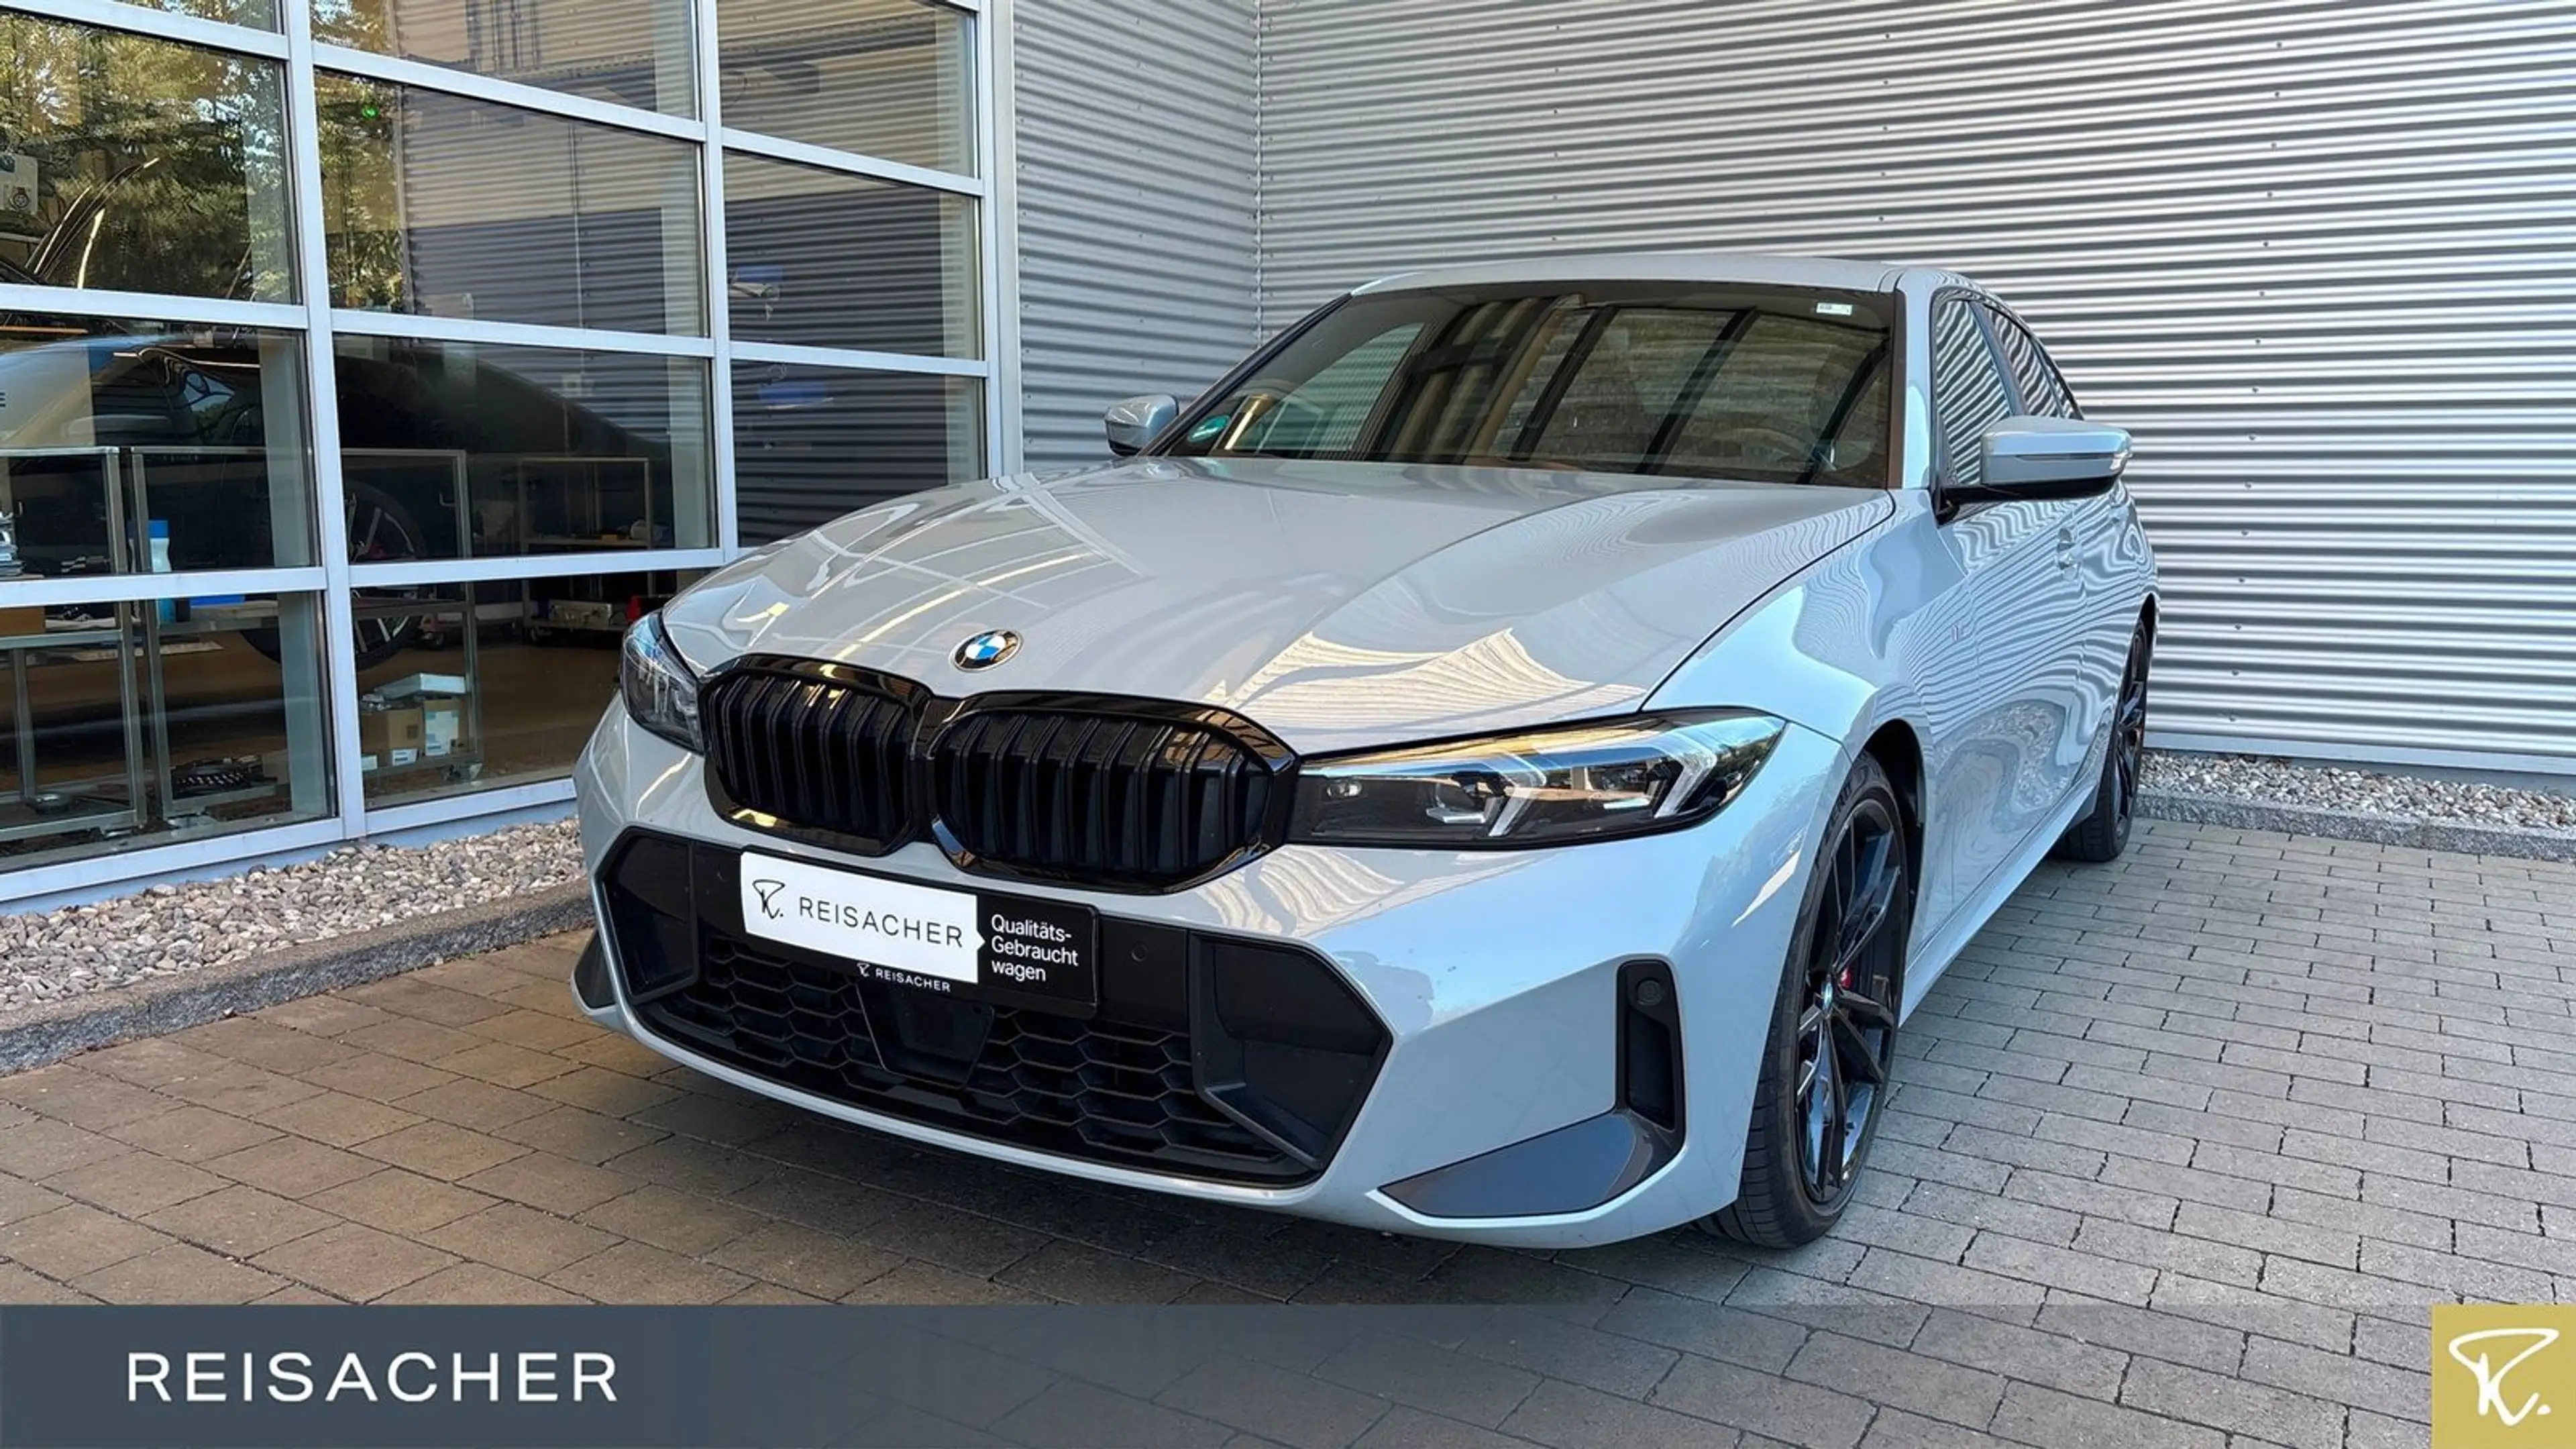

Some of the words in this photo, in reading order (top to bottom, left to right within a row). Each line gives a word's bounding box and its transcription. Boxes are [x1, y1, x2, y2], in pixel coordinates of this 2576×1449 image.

[800, 896, 963, 948] REISACHER
[991, 914, 1072, 943] Qualitäts-
[991, 934, 1079, 967] Gebraucht
[875, 967, 951, 992] REISACHER
[991, 960, 1046, 983] wagen
